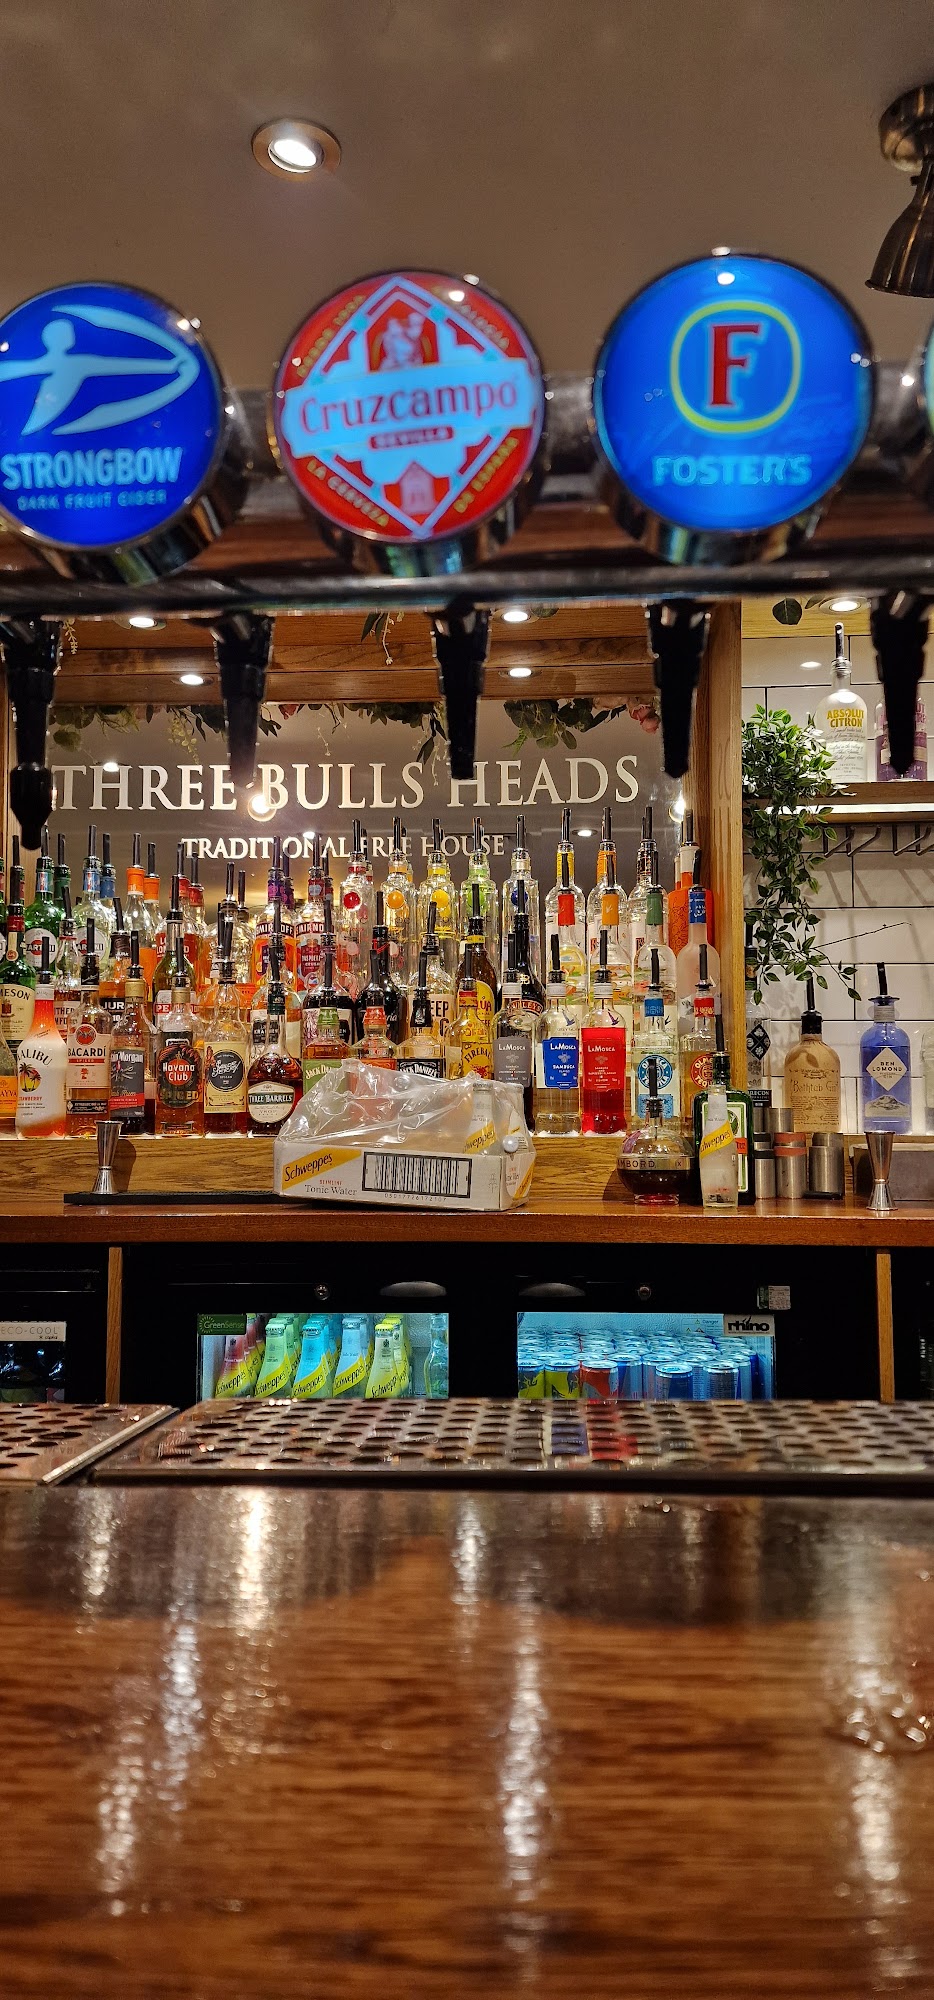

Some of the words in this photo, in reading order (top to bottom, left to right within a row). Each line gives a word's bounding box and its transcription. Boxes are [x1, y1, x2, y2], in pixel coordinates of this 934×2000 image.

[709, 323, 760, 406] F
[300, 381, 517, 434] Cruzcampo
[0, 446, 183, 491] STRONGBOW
[652, 454, 812, 487] FOSTER'S
[17, 495, 60, 511] DARK
[64, 491, 112, 509] FRUIT
[117, 489, 167, 506] CIDER
[827, 708, 864, 719] ABSOLUT
[830, 717, 862, 728] CITRON
[51, 764, 237, 811] THREE
[257, 761, 424, 810] BULLS
[447, 755, 640, 807] HEADS
[181, 836, 350, 859] TRADITONAL
[420, 835, 505, 857] HOUSE
[256, 922, 294, 936] SMIROFF
[296, 922, 325, 936] SMIRNO
[510, 1000, 542, 1014] AILEYS
[68, 1046, 106, 1057] BACARDÍ
[119, 1051, 144, 1063] Morgan
[464, 1047, 491, 1063] FIREBAL
[163, 1062, 196, 1072] Havana
[695, 1057, 713, 1069] OLME
[169, 1072, 188, 1081] Club
[306, 1069, 321, 1079] JACK
[695, 1074, 713, 1088] TEQU
[249, 1095, 265, 1103] THREE
[265, 1094, 292, 1104] BARRELS
[463, 1130, 495, 1153] hweppes
[700, 1130, 732, 1153] chweppes
[285, 1152, 333, 1182] Schweppes
[304, 1184, 329, 1194] Tonic
[331, 1186, 357, 1196] Water
[0, 1326, 58, 1334] ECO-COOL
[203, 1320, 245, 1329] GreenSense
[727, 1316, 770, 1332] rhino
[371, 1375, 398, 1399] Schwepp
